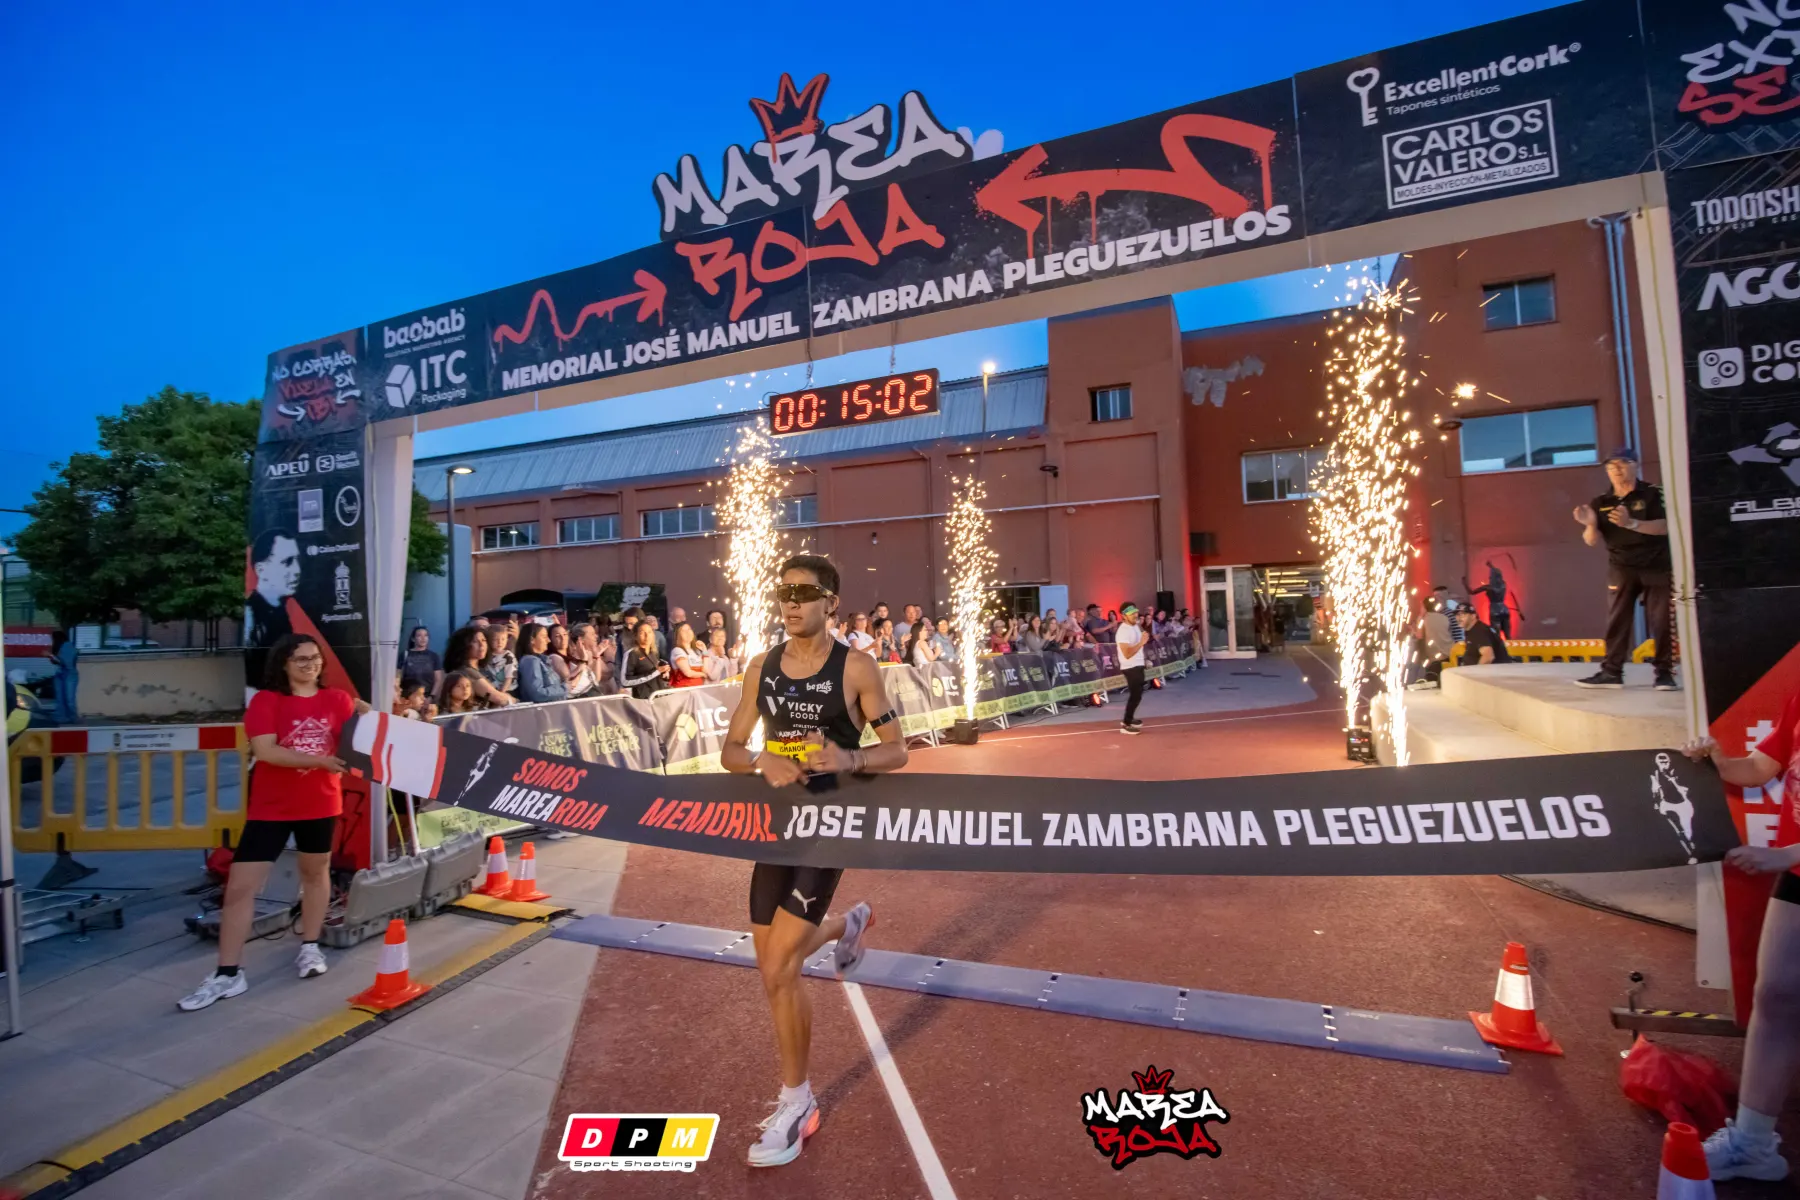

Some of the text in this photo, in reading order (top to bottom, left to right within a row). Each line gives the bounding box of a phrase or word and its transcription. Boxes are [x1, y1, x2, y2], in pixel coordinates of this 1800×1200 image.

[1386, 84, 1500, 115] Tapones sintéticos
[1392, 108, 1544, 160] CARLOS
[657, 91, 965, 232] MAREA
[1394, 142, 1548, 184] VALERO S.L.
[675, 183, 945, 321] ROJA
[502, 205, 1292, 391] MEMORIAL JOSÉ MANUEL ZAMBRANA PLEGUEZUELOS
[384, 308, 465, 349] baobab
[420, 349, 467, 391] ITC
[1752, 362, 1800, 383] CO
[422, 388, 466, 404] Packaging
[697, 706, 729, 729] ITC
[787, 702, 824, 713] VICKY
[790, 712, 819, 720] FOODS
[512, 757, 588, 793] SOMOS
[638, 794, 1611, 847] MEMORIAL JOSE MANUEL ZAMBRANA PLEGUEZUELOS
